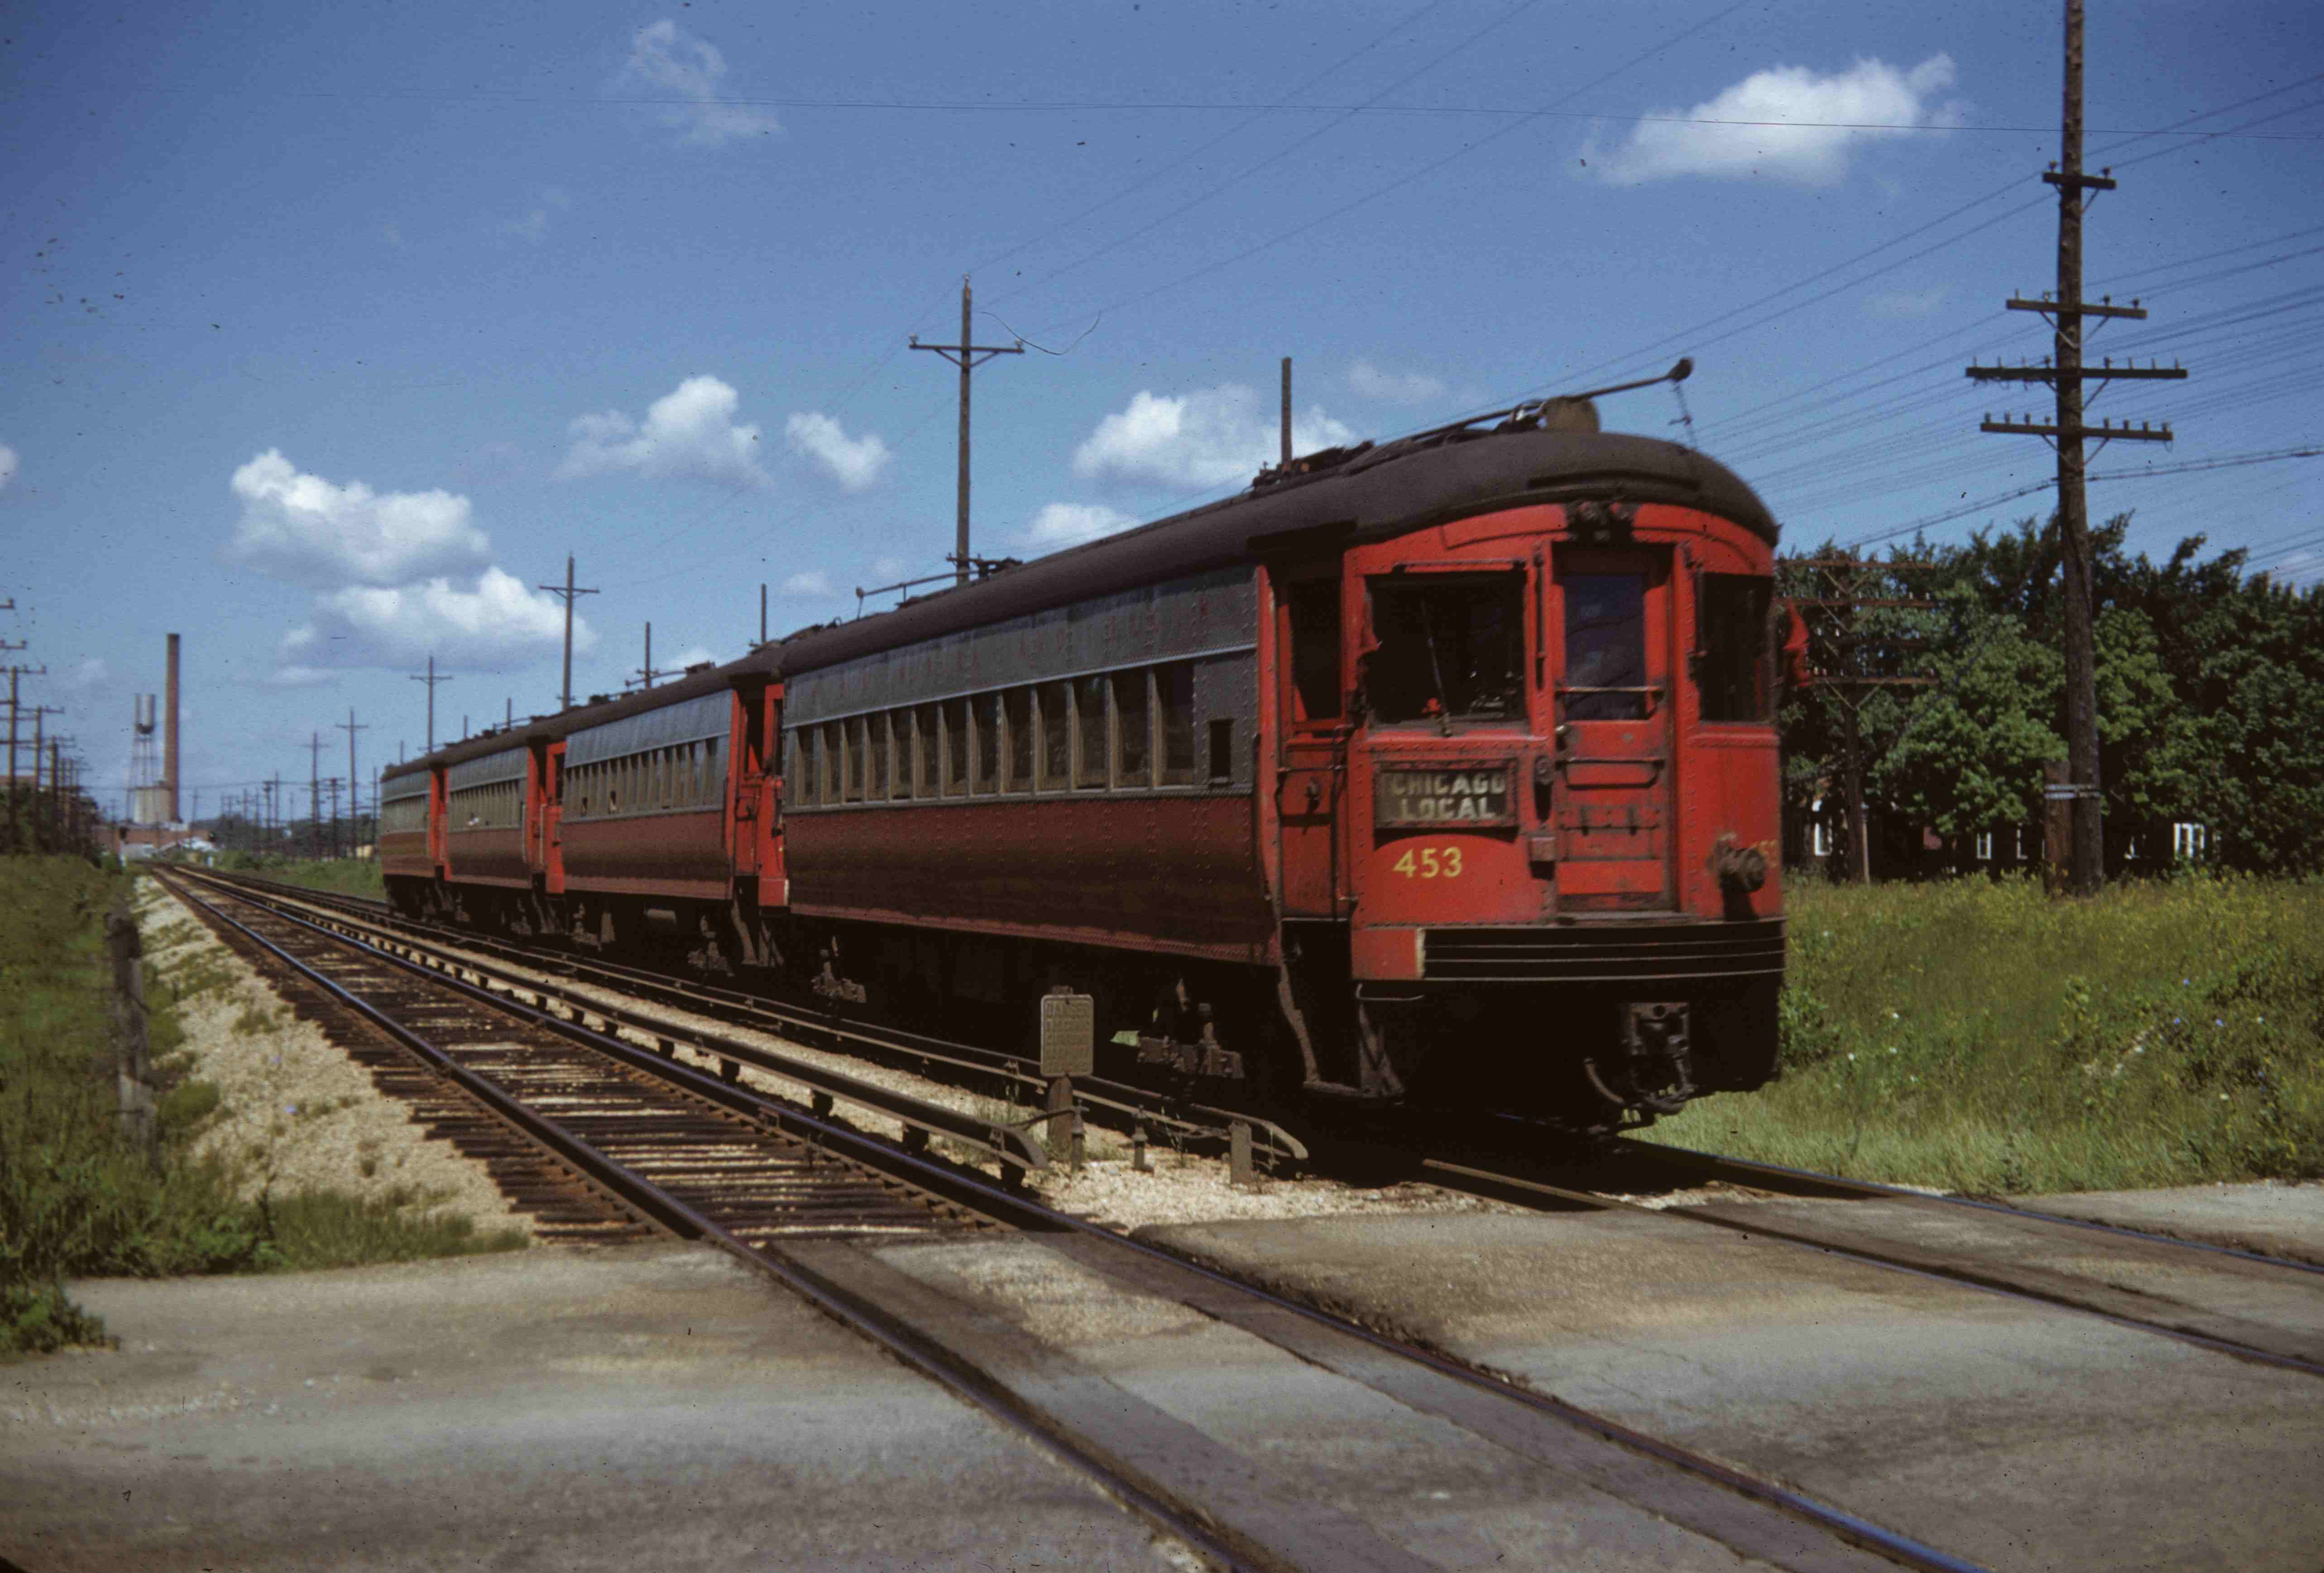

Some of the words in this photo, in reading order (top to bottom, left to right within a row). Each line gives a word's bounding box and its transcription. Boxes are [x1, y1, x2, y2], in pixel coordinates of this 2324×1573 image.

[1390, 774, 1506, 795] CHICAGO
[1401, 797, 1496, 819] LOCAL
[1391, 847, 1462, 878] 453
